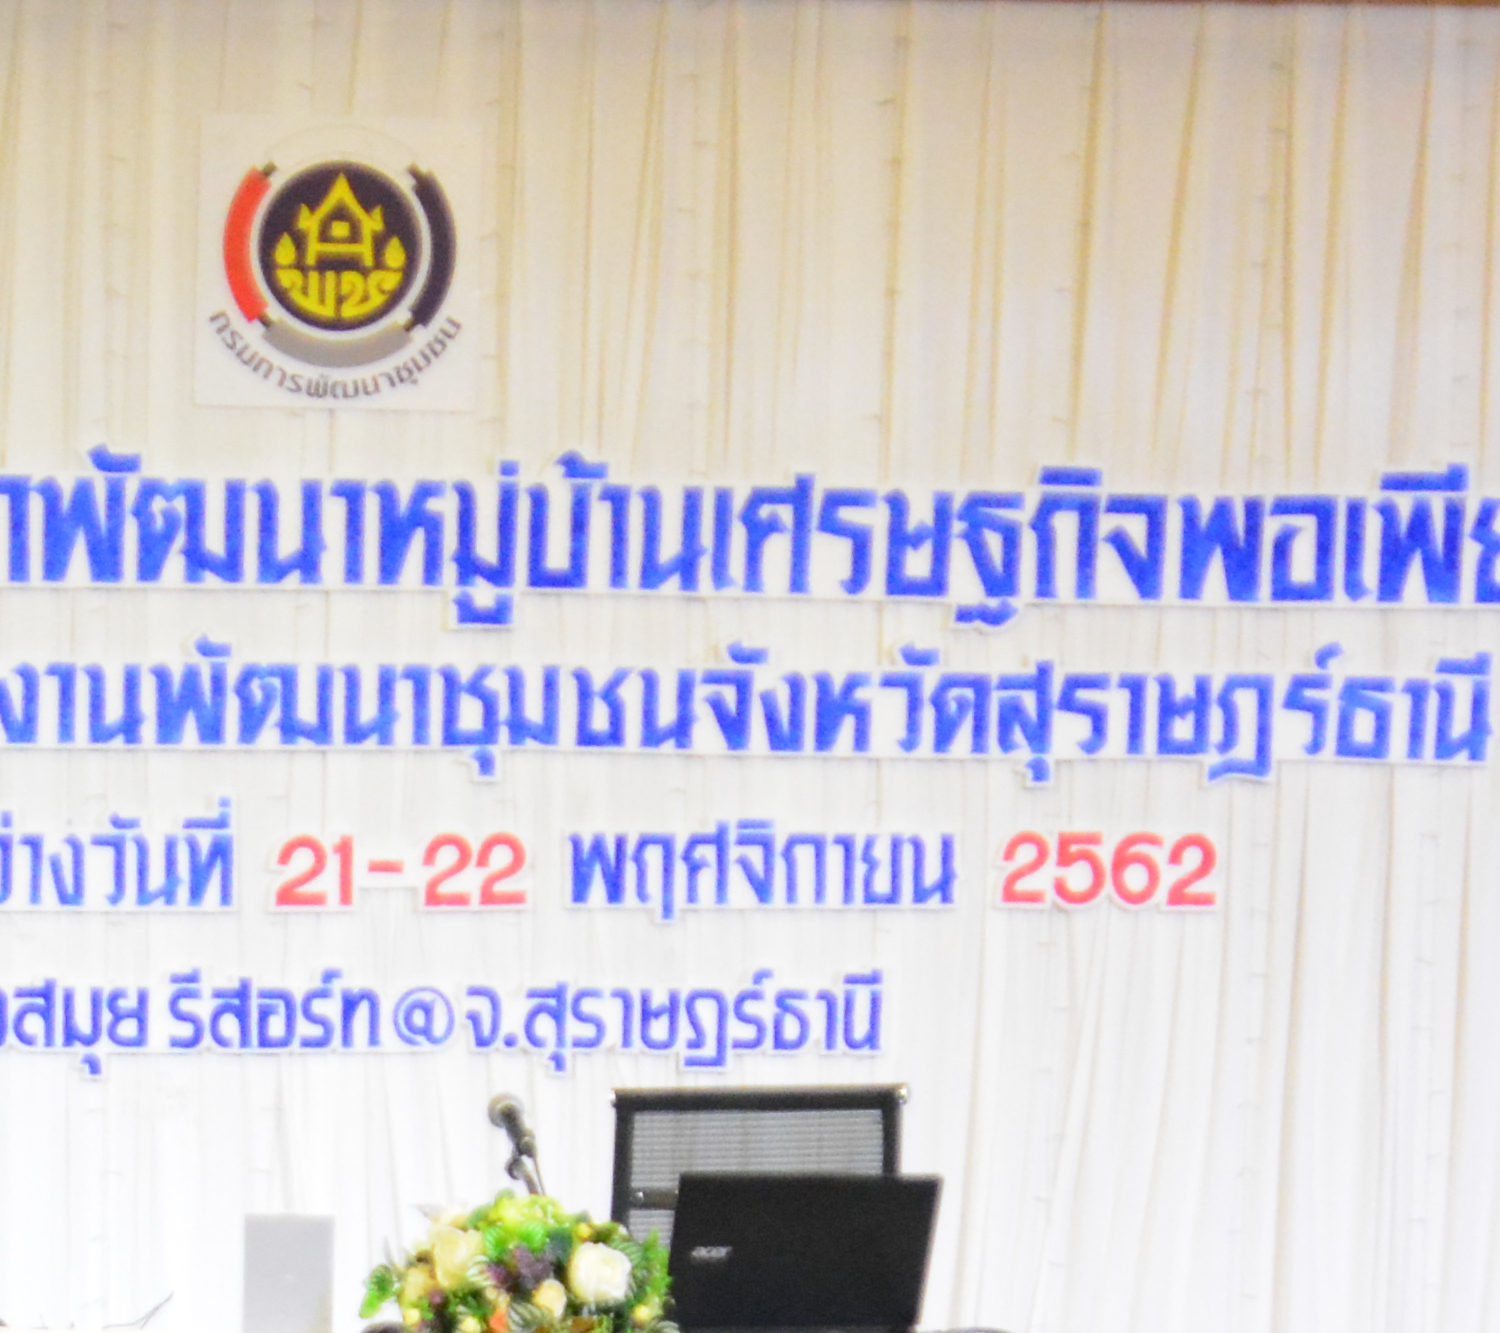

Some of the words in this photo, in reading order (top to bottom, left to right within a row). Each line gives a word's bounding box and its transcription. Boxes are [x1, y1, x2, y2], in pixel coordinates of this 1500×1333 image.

[208, 309, 463, 400] กรมการพัฒนาชุมชน
[274, 832, 528, 906] 21-22
[567, 818, 958, 921] พฤศจิกายน
[1000, 830, 1218, 906] 2562
